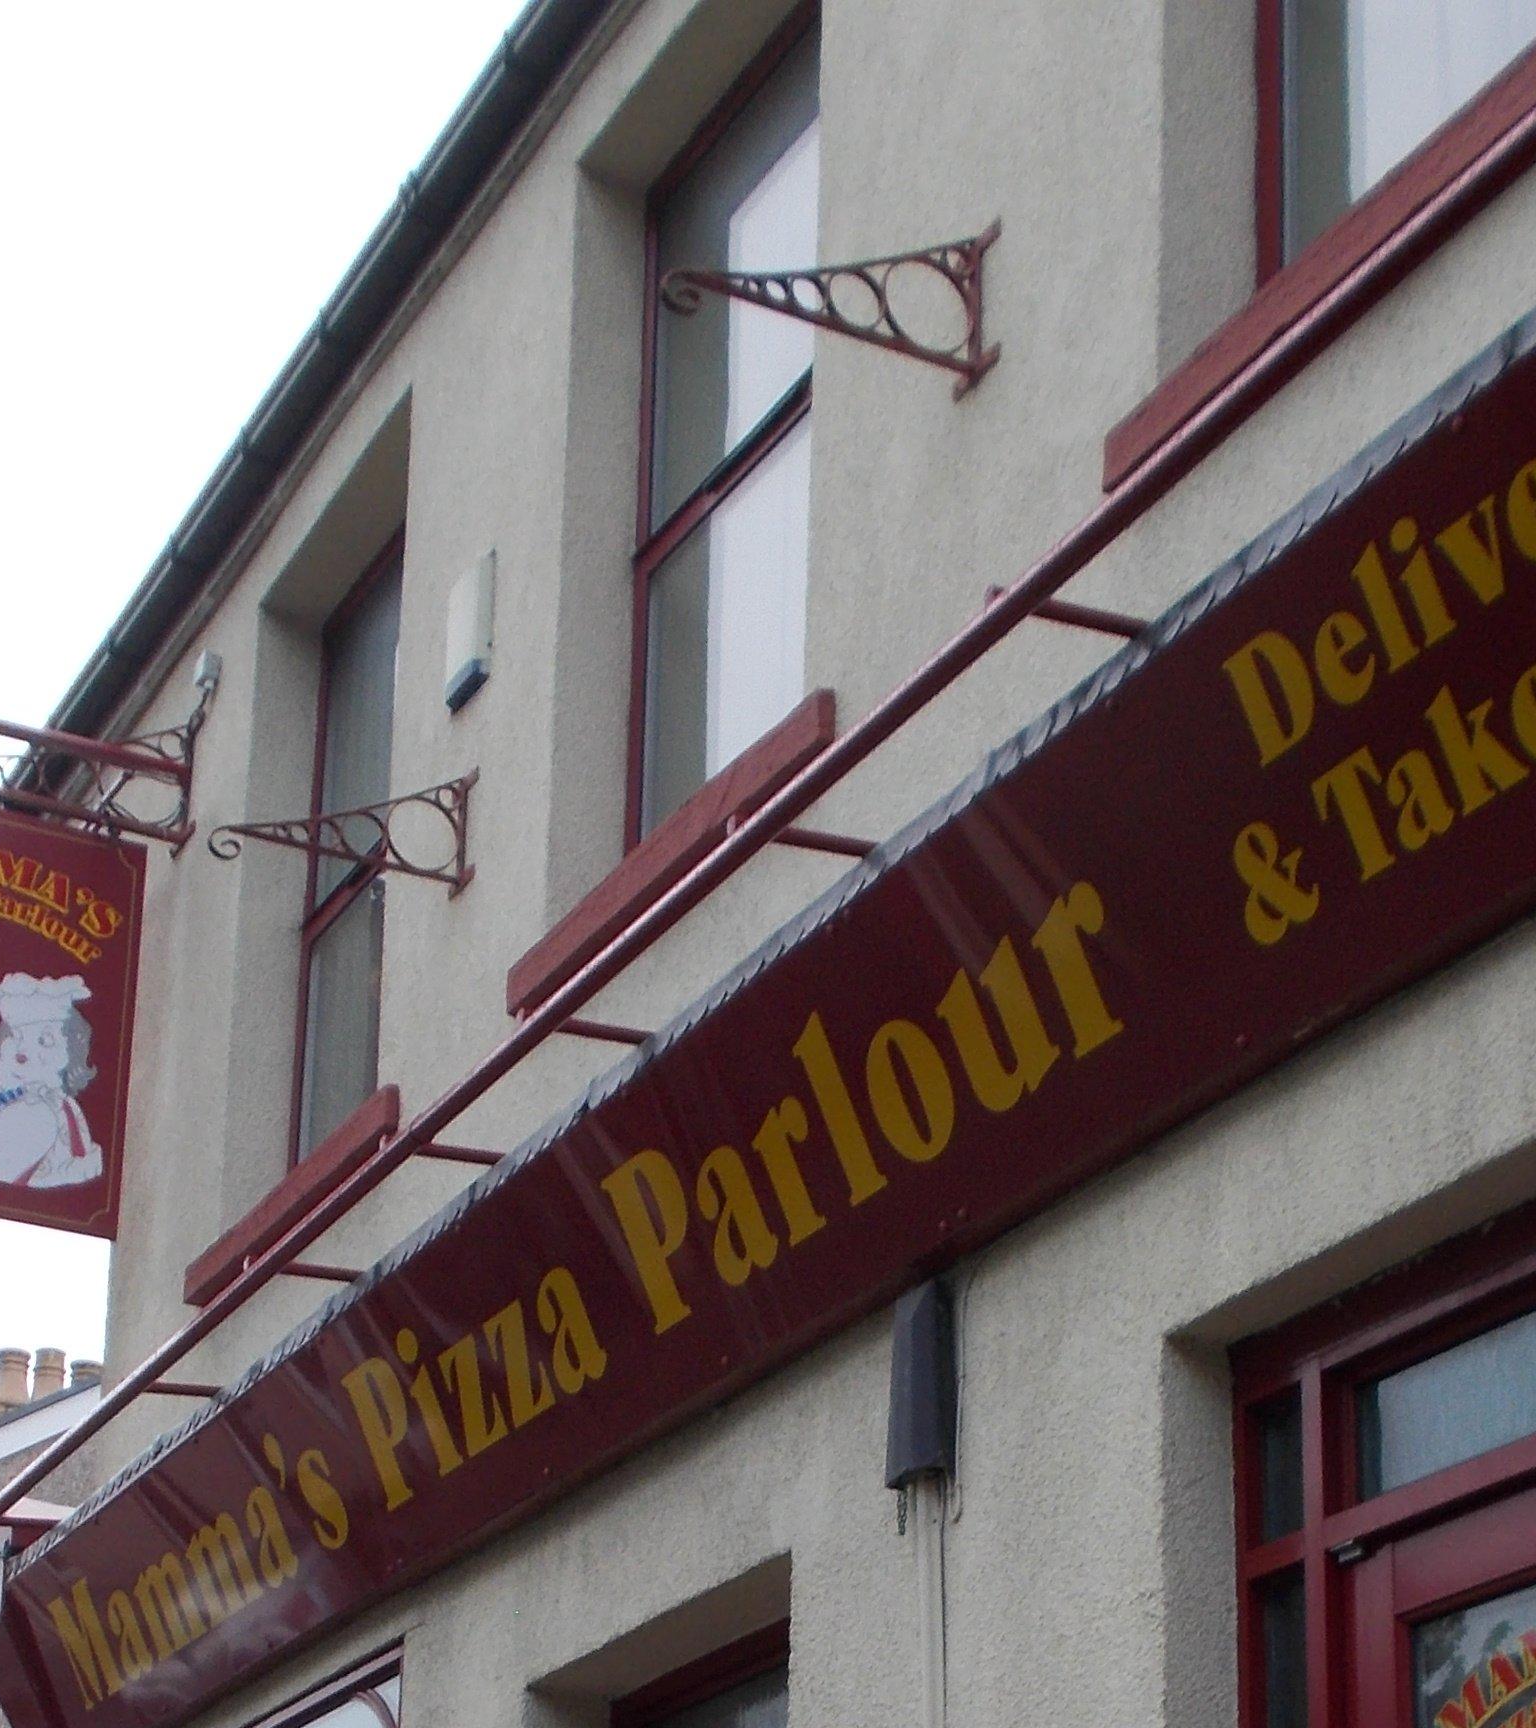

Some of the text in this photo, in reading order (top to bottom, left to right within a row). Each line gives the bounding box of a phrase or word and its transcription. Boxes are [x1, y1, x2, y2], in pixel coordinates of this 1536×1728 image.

[1232, 821, 1320, 945] &
[49, 881, 1125, 1711] Mamma's Pizza Parlour
